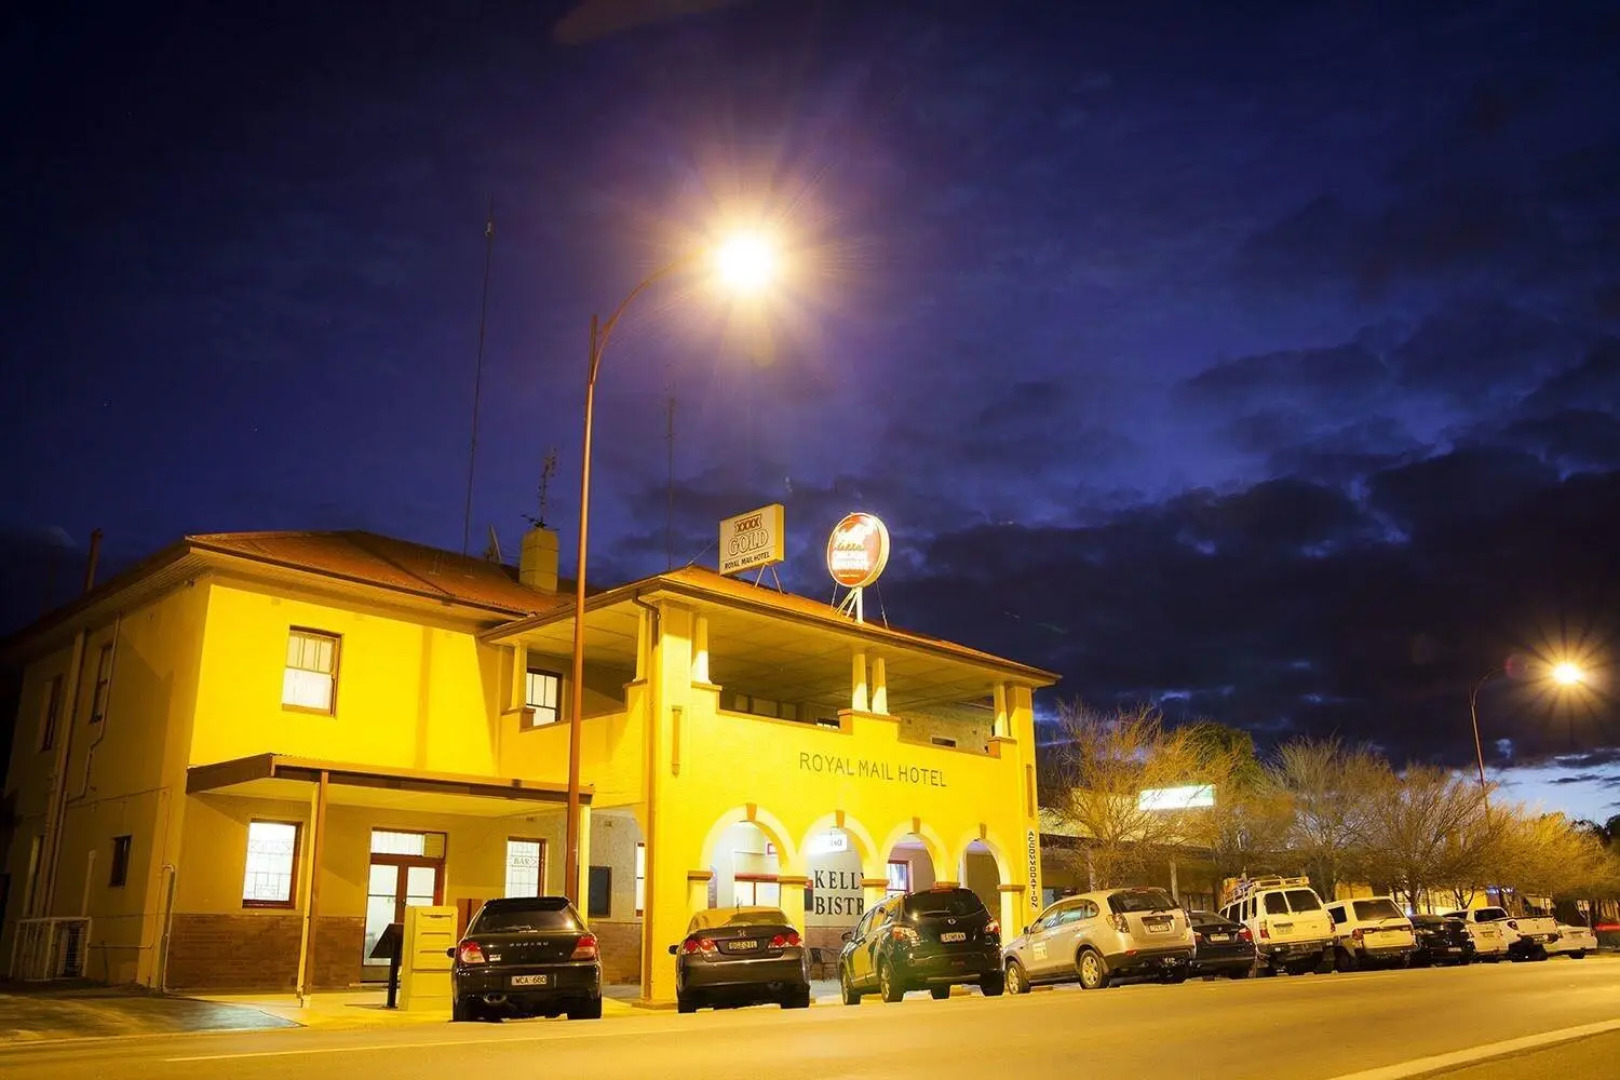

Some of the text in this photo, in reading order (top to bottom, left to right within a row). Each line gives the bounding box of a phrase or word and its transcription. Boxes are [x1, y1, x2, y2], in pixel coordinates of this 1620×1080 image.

[737, 517, 759, 532] XXXX
[728, 529, 769, 556] GOLD
[724, 551, 770, 570] ROYAL MAIL HOTEL
[799, 752, 947, 787] ROYAL MAIL HOTEL
[1028, 830, 1038, 908] ACCOMMODATION
